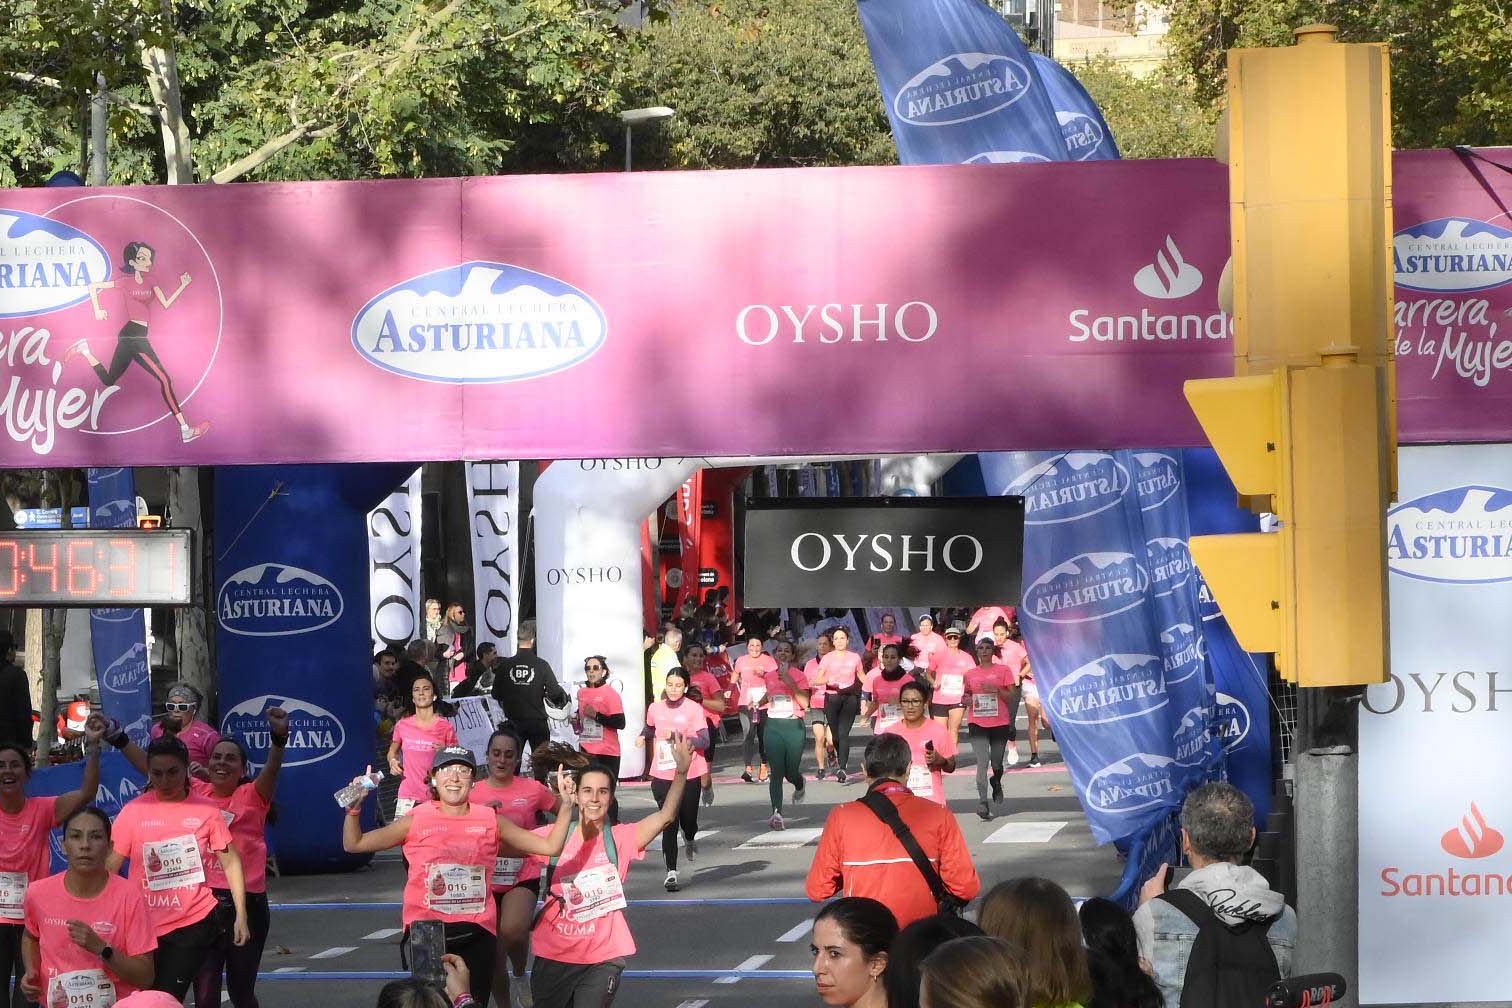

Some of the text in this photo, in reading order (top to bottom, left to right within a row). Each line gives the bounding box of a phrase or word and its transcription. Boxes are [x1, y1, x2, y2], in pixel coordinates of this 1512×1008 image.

[13, 244, 87, 257] LECHERA
[1464, 240, 1512, 250] LECHER
[735, 301, 938, 346] OYSHO
[1394, 298, 1489, 328] arrera
[371, 308, 586, 353] ASTURIANA
[1069, 308, 1234, 343] Santand
[1418, 328, 1435, 355] la
[1416, 519, 1481, 530] CENTRAL
[791, 532, 984, 574] OYSHO
[547, 565, 623, 586] OYSHO
[234, 588, 329, 596] CENTRAL LECHERA
[222, 593, 334, 620] ASTURIANA
[447, 883, 468, 892] 016
[1380, 867, 1512, 897] Santan
[144, 893, 182, 907] UMA
[556, 922, 596, 936] SUMA
[70, 993, 94, 1004] 016
